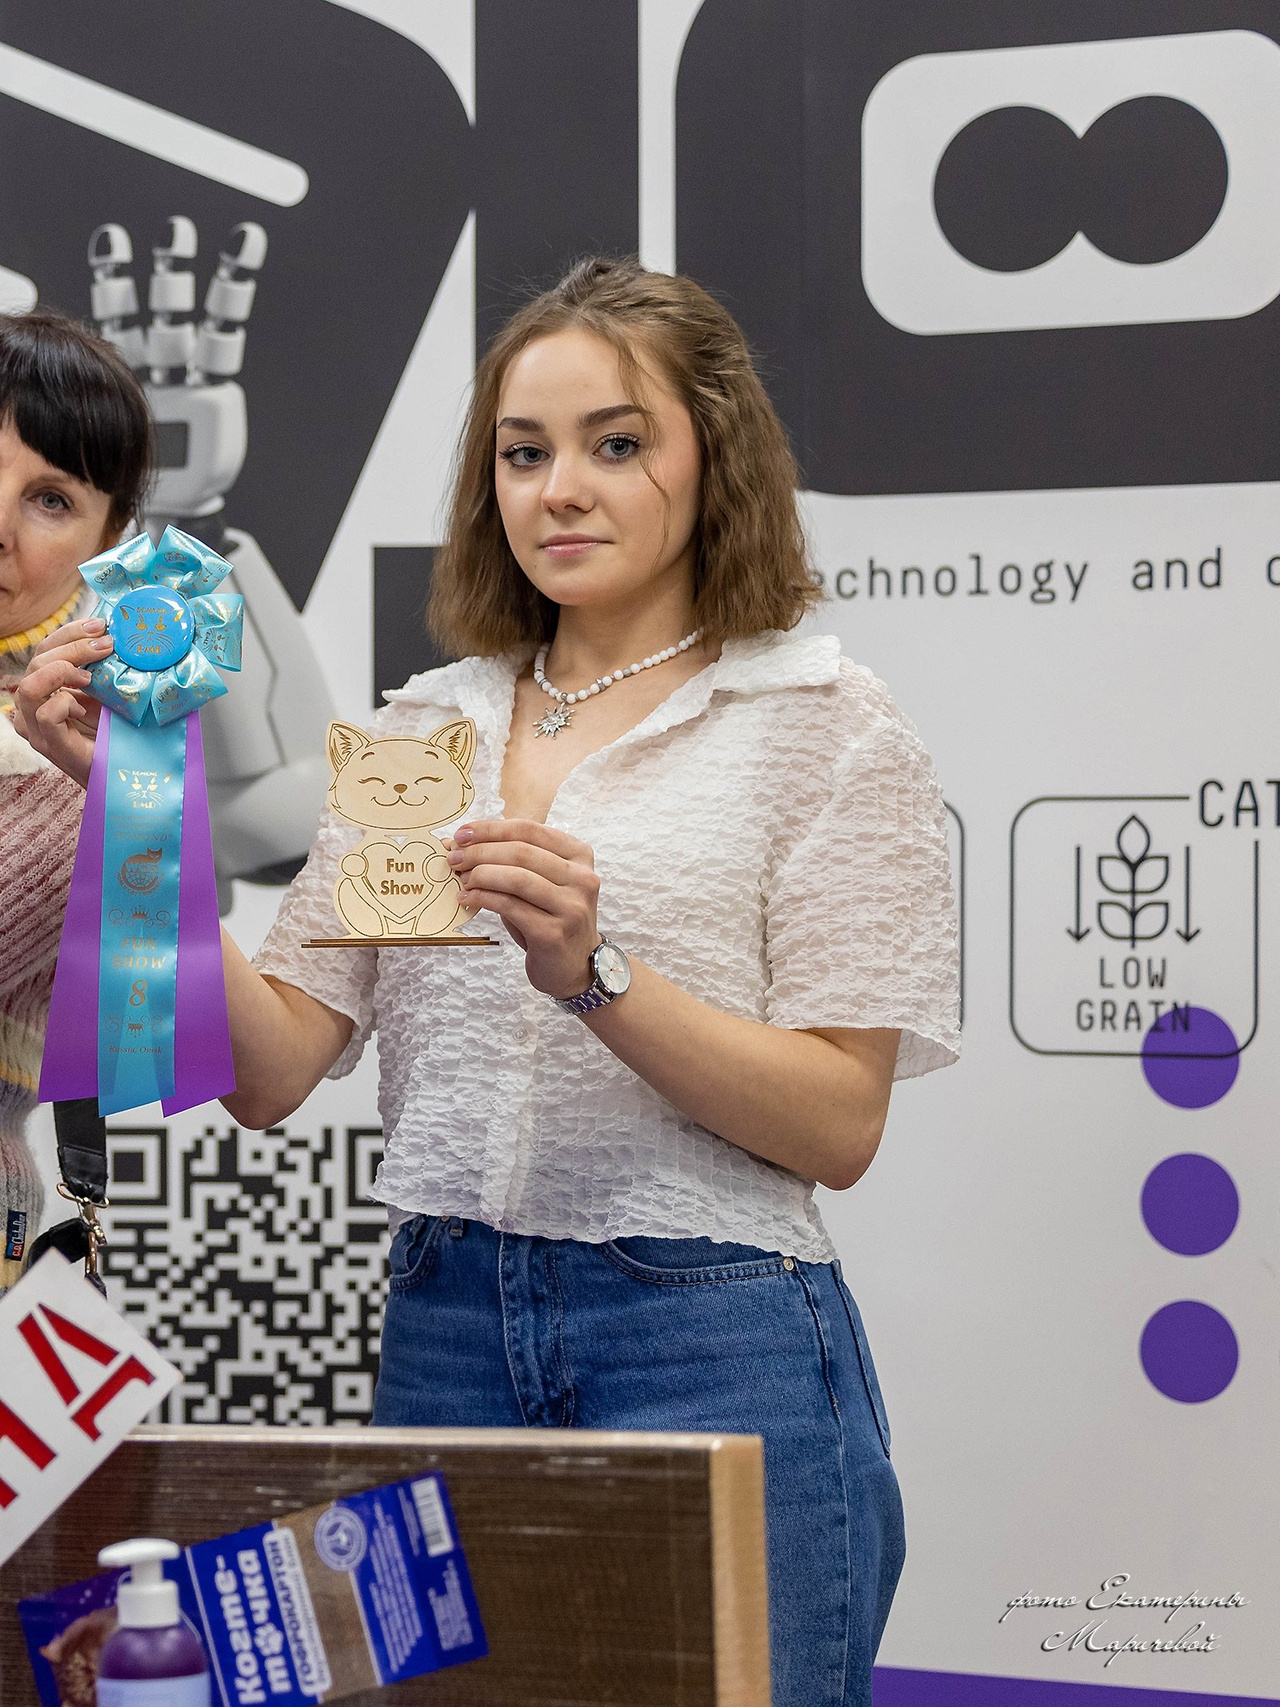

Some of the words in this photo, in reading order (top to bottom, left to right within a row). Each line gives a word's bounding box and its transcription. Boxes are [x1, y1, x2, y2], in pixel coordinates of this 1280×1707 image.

[818, 553, 1089, 603] chnology
[1132, 547, 1222, 589] and
[386, 858, 415, 873] Fun
[380, 879, 425, 896] Show
[121, 936, 159, 950] FUN
[111, 955, 166, 969] SHOW
[1100, 957, 1168, 989] LOW
[128, 979, 148, 1007] 8
[1076, 999, 1190, 1034] GRAIN
